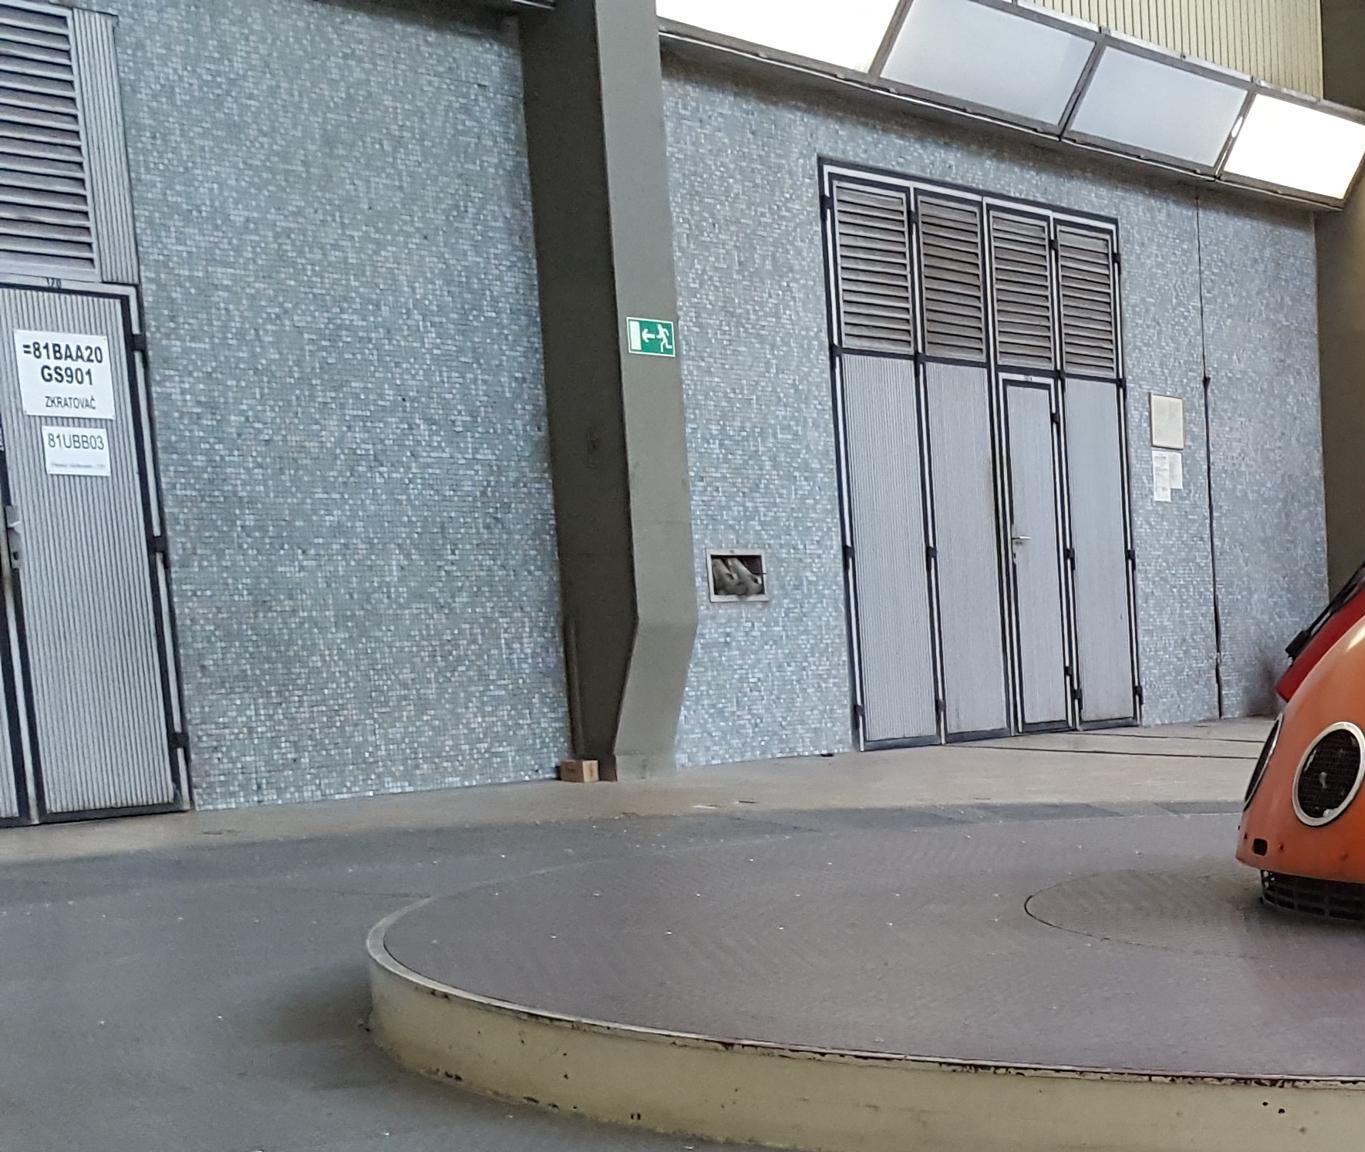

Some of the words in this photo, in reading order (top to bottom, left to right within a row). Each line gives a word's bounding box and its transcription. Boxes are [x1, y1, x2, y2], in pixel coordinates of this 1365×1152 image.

[22, 341, 103, 363] =81BAA20
[41, 365, 93, 385] GS901
[45, 395, 96, 409] ZKRATOVAČ
[48, 433, 104, 450] 81UBB03
